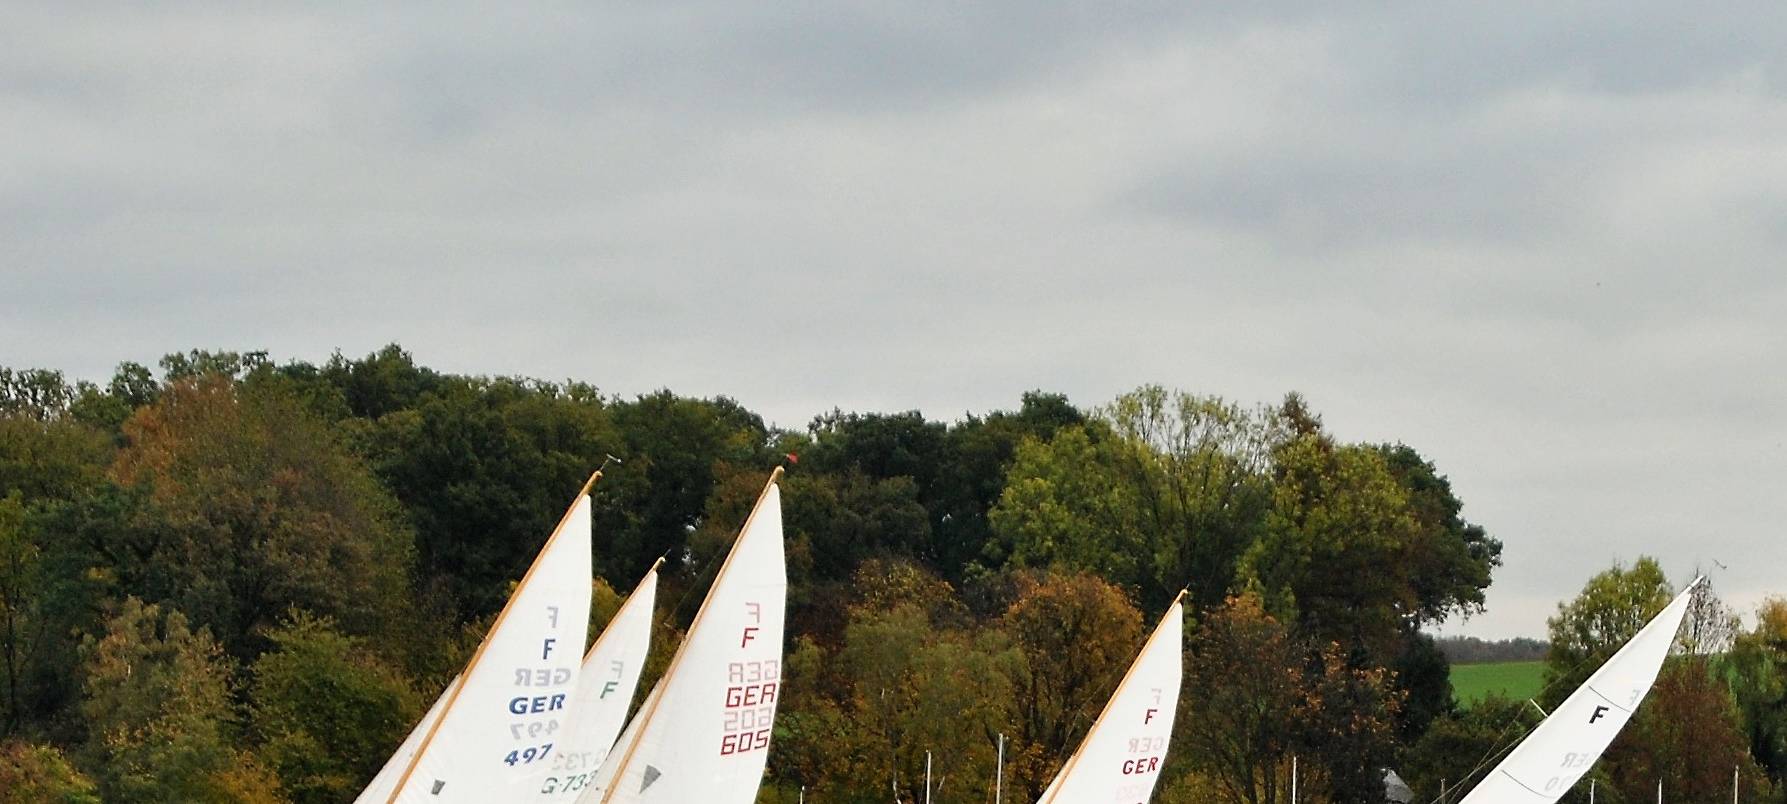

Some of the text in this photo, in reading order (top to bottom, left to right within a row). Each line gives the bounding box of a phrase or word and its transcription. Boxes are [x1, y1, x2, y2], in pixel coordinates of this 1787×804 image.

[741, 627, 759, 648] F
[542, 638, 556, 660] F
[599, 681, 619, 699] F
[725, 682, 777, 708] GER
[508, 693, 566, 715] GER
[1588, 705, 1610, 724] F
[1144, 708, 1158, 725] F
[720, 728, 770, 756] 605
[503, 743, 553, 767] 497
[1122, 756, 1159, 775] GER
